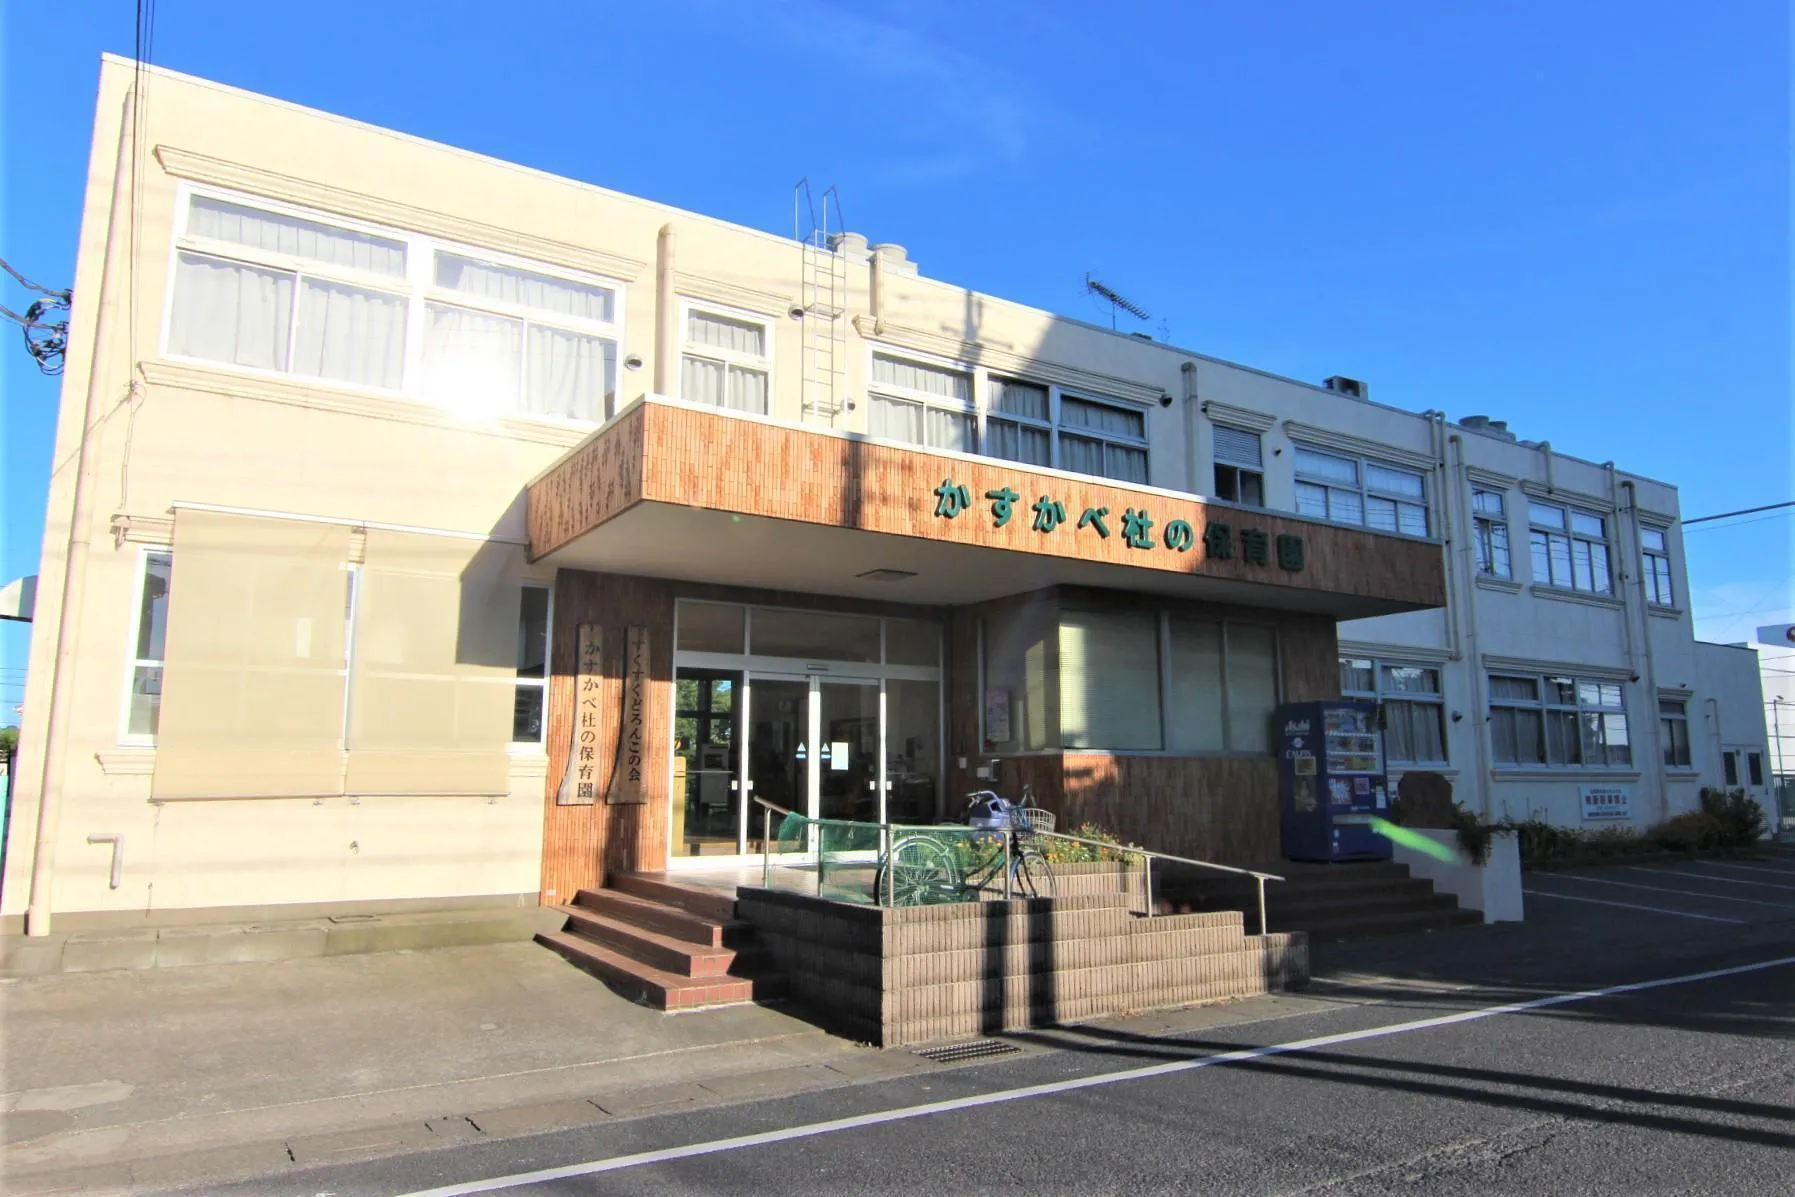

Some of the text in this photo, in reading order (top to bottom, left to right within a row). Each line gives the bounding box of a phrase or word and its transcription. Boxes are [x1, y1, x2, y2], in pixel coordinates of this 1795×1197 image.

[934, 478, 1305, 571] かすかべ杜の保育園
[577, 642, 599, 798] かすかべ杜の保育園
